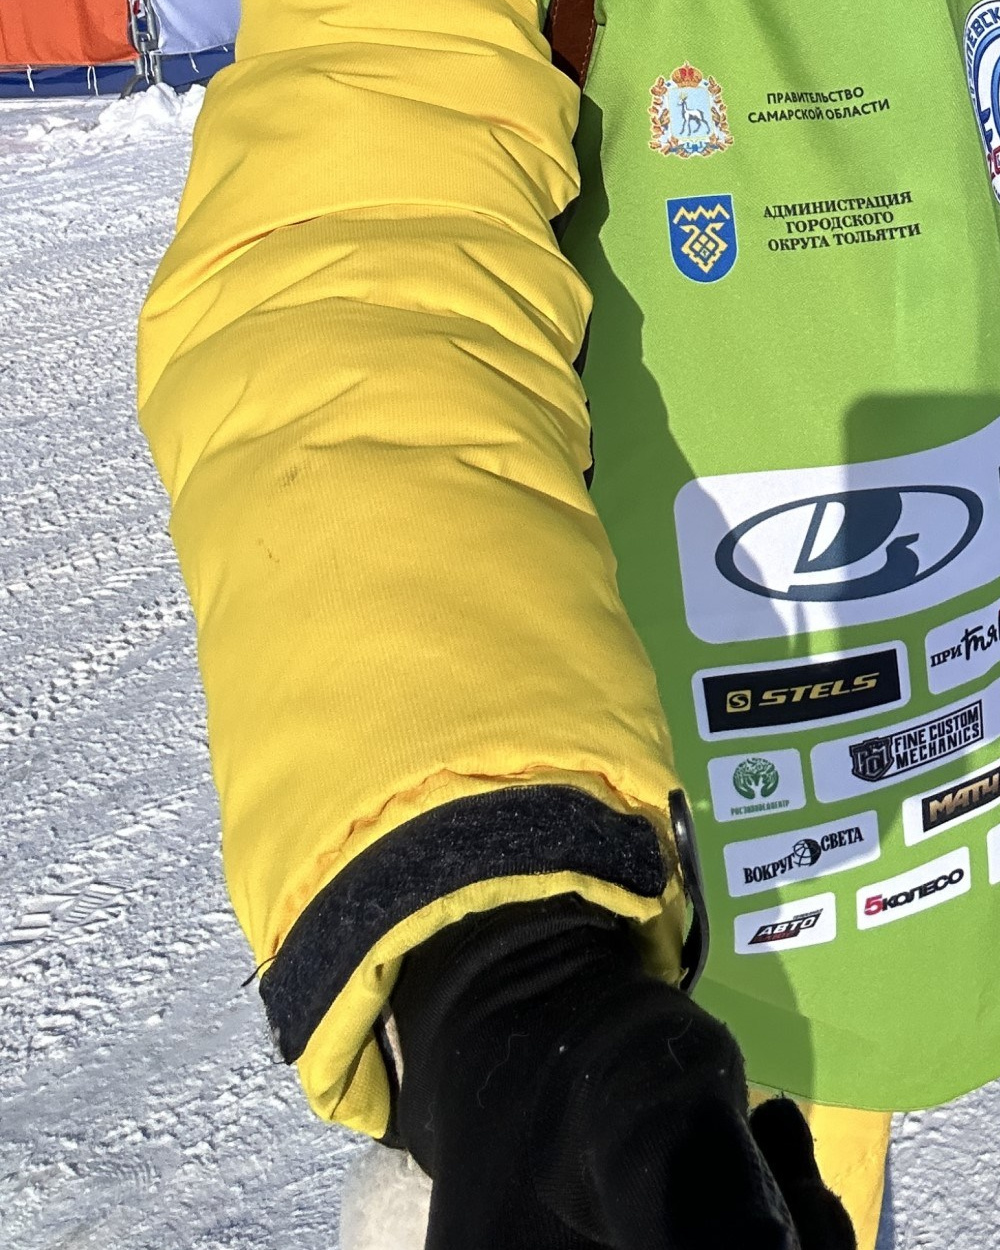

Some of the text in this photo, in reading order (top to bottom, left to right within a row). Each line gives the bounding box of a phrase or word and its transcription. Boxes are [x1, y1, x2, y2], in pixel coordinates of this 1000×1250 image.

[766, 87, 865, 105] ПРАВИТЕЛЬСТВО
[747, 99, 891, 124] САМАРСКОЙ ОБЛАСТИ
[763, 191, 914, 220] АДМИНИСТРАЦИЯ
[786, 211, 895, 234] ГОРОДСКОГО
[768, 223, 922, 252] ОКРУГА ТОЛЬЯТТИ
[759, 672, 880, 707] STELS
[894, 706, 979, 753] FINE CUSTOM
[896, 722, 980, 770] MECHANICS
[743, 826, 864, 884] ВОКРУГ СВЕТА
[757, 916, 816, 936] АВТО
